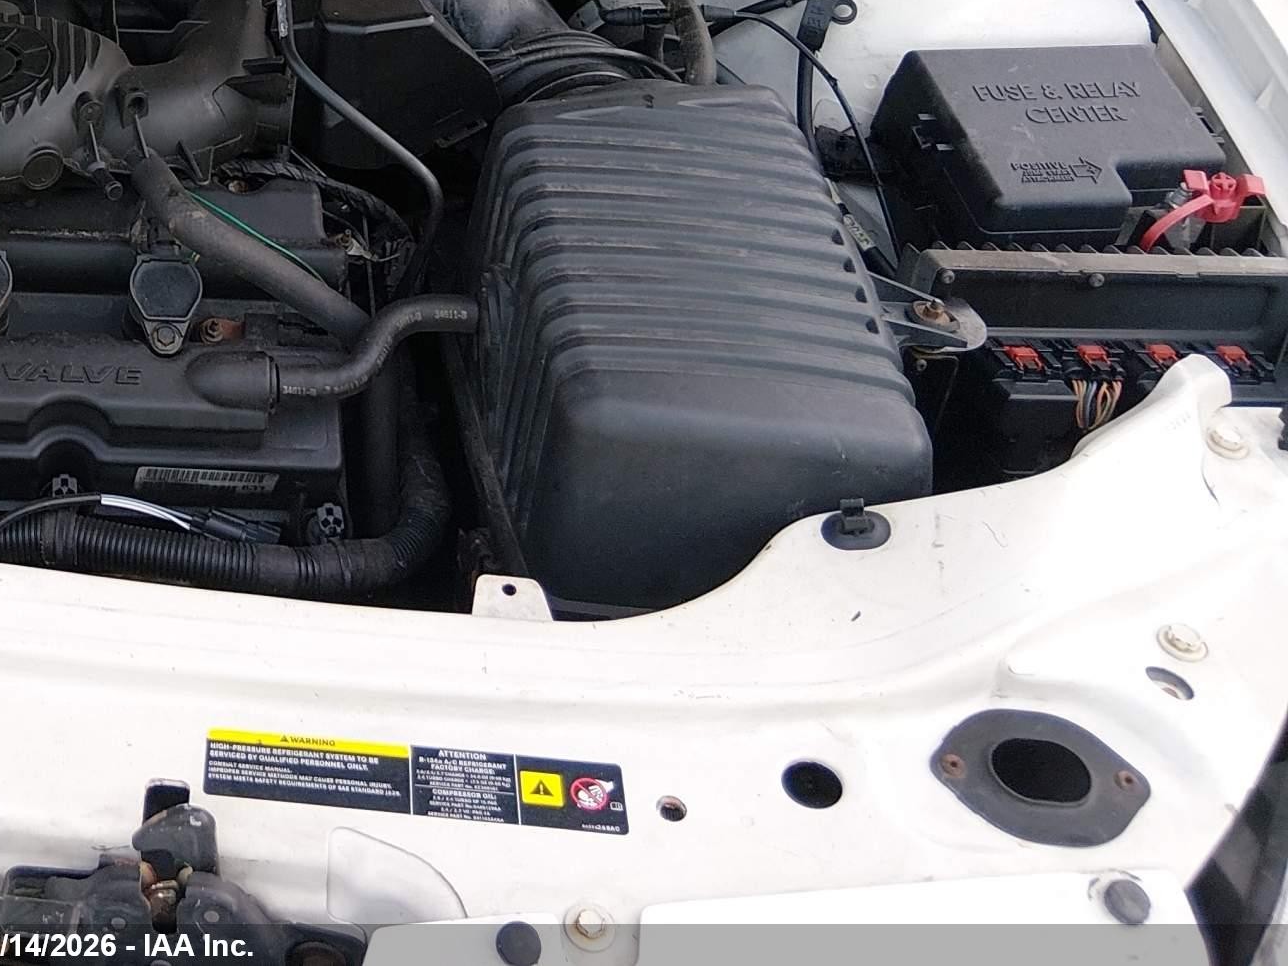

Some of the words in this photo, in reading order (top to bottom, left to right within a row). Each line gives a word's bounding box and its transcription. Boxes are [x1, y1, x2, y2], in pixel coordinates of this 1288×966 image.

[972, 83, 1038, 102] FUSE
[1040, 83, 1062, 100] &
[1064, 81, 1142, 99] RELAY
[1024, 104, 1129, 124] CENTER
[1010, 161, 1069, 171] POSITIVE
[2, 361, 144, 386] VALVE
[290, 736, 336, 747] WARNING
[210, 742, 271, 754] HIGH-PRESSURE
[272, 748, 324, 759] REFRIGERANT
[325, 753, 356, 763] SYSTEM
[357, 755, 367, 764] TO
[368, 757, 379, 765] BE
[438, 749, 487, 761] ATTENTION
[209, 750, 246, 760] SERVICED
[248, 753, 258, 761] BY
[258, 754, 299, 764] QUALIFIED
[300, 758, 346, 769] PERSONNEL
[346, 762, 369, 771] ONLY.
[458, 760, 507, 770] REFRIGERANT
[430, 764, 463, 772] FACTORY
[208, 767, 240, 775] IMPROPER
[334, 778, 368, 787] PERSONAL
[350, 786, 384, 795] STANDARD
[432, 788, 482, 799] COMPRESSOR
